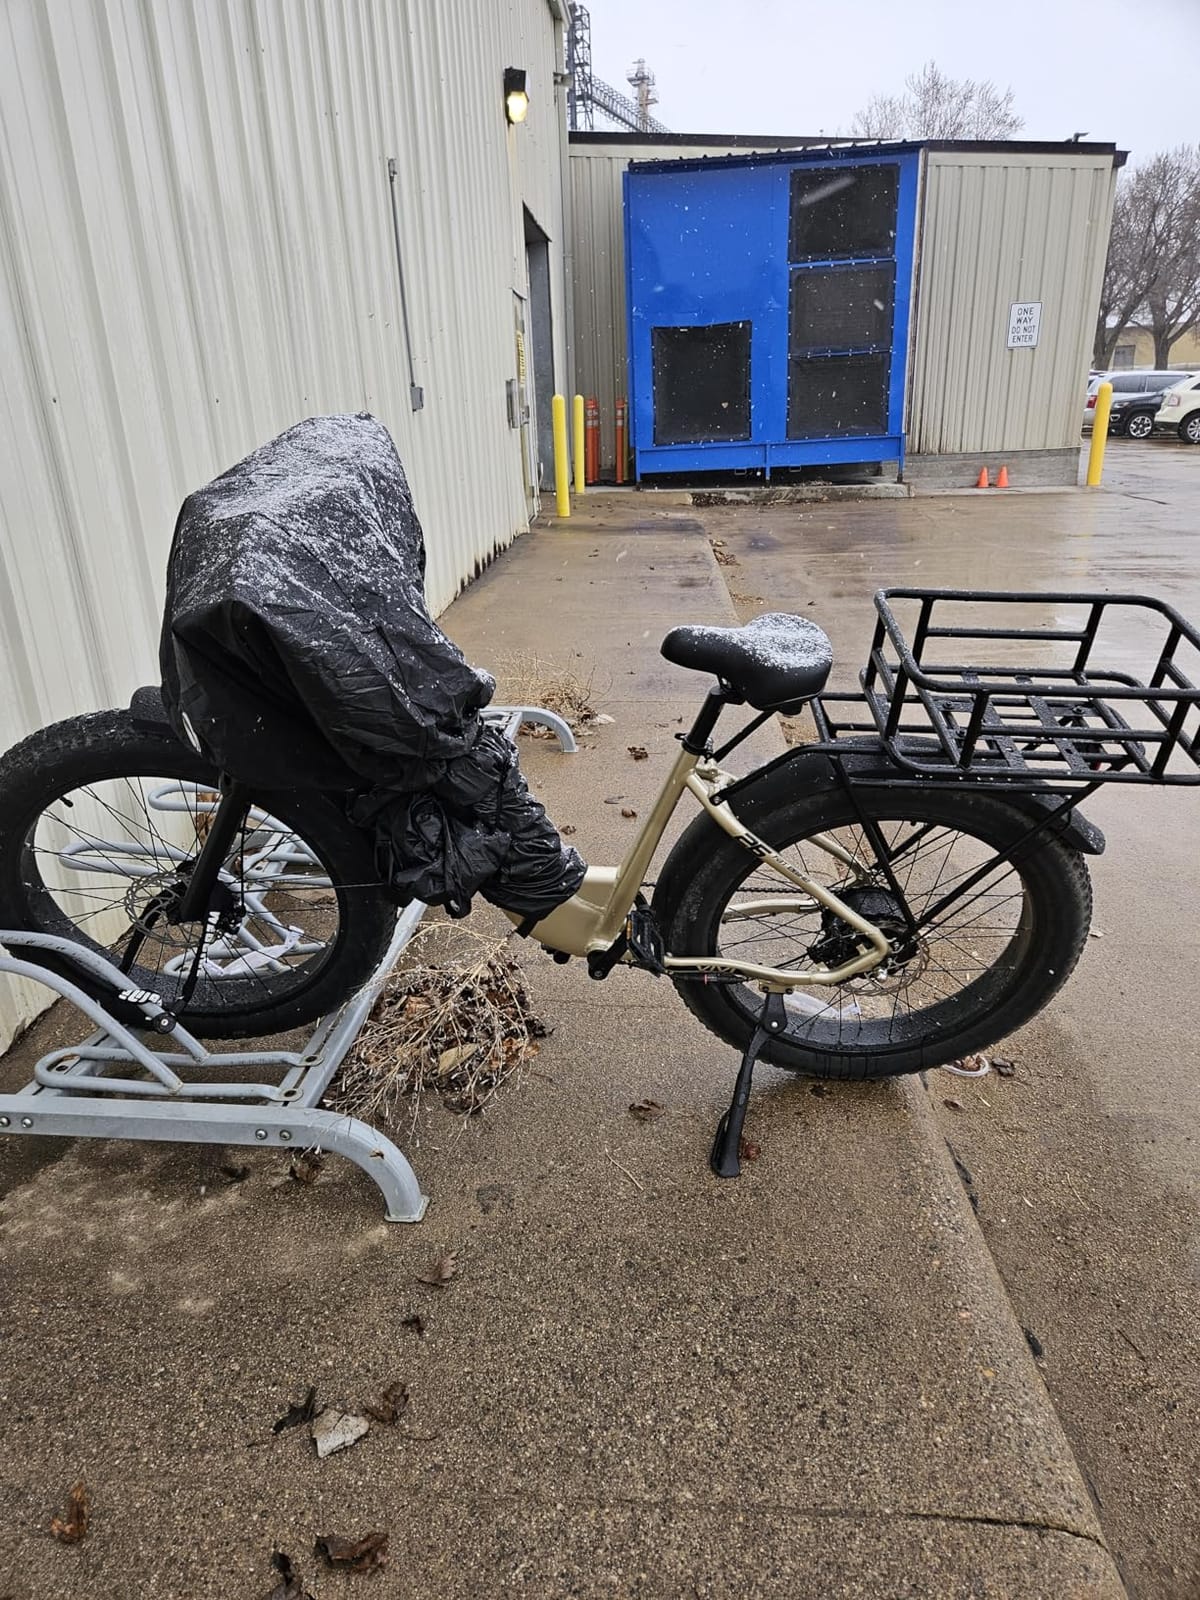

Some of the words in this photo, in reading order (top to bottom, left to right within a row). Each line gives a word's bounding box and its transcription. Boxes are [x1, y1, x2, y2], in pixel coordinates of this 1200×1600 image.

[1017, 307, 1034, 316] ONE
[1016, 316, 1033, 325] WAY
[1011, 326, 1021, 334] DO
[1023, 325, 1036, 333] NOT
[1012, 335, 1033, 343] ENTER
